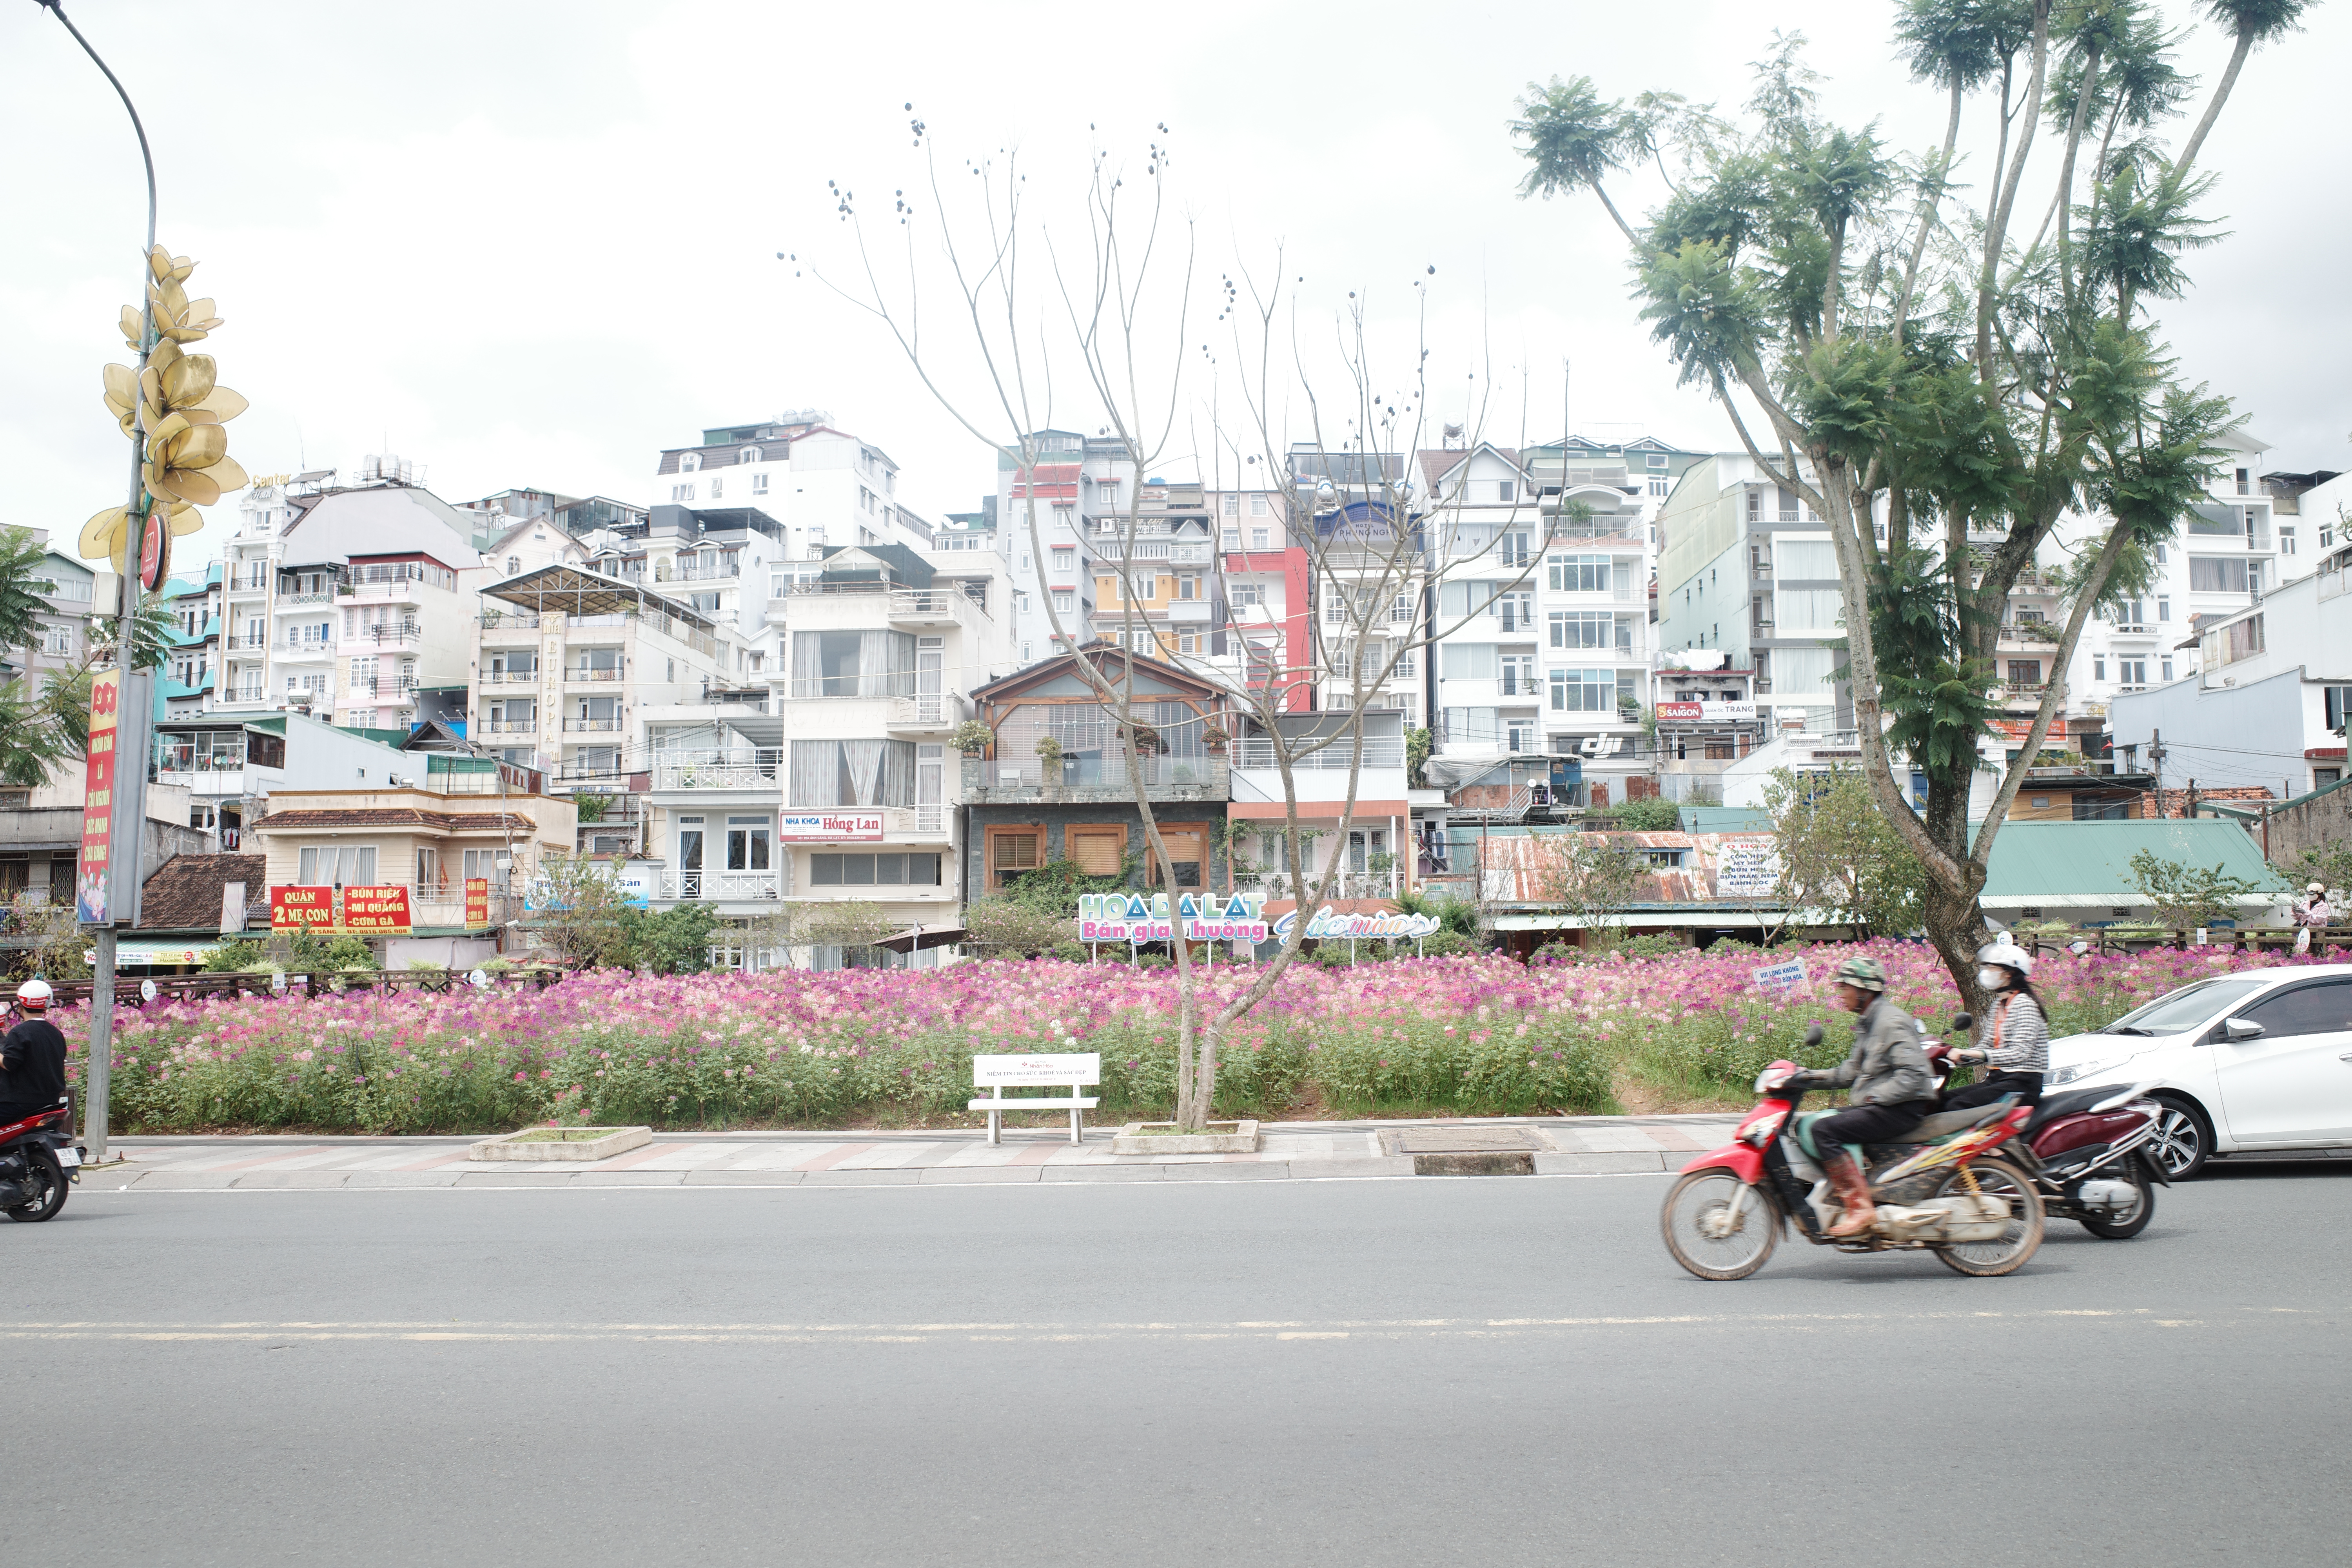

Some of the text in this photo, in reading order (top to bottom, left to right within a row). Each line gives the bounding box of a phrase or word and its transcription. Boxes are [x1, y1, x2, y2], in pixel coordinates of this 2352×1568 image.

[252, 473, 291, 488] Center
[544, 624, 561, 634] HOTEL
[544, 641, 557, 742] EUROPA
[91, 732, 113, 754] NHÂN DÂN
[97, 760, 103, 780] LÀ
[86, 815, 107, 837] SỨC MẠNH
[823, 814, 854, 833] Hồng
[857, 817, 879, 829] Lan
[85, 839, 107, 862] CỦA ĐẢNG!
[376, 887, 399, 898] RIÊU
[477, 879, 486, 891] RIÊU
[285, 889, 315, 903] QUÁN
[274, 906, 328, 925] 2 MẸ CON
[368, 901, 404, 913] QUẢNG
[478, 909, 483, 920] GÀ
[1082, 895, 1149, 920] HOA
[1203, 894, 1265, 920] LẠT
[379, 917, 394, 926] GÀ
[1082, 920, 1265, 944] Bản gia hưởng
[1769, 969, 1782, 977] LÒNG
[1782, 965, 1799, 974] KHÔNG
